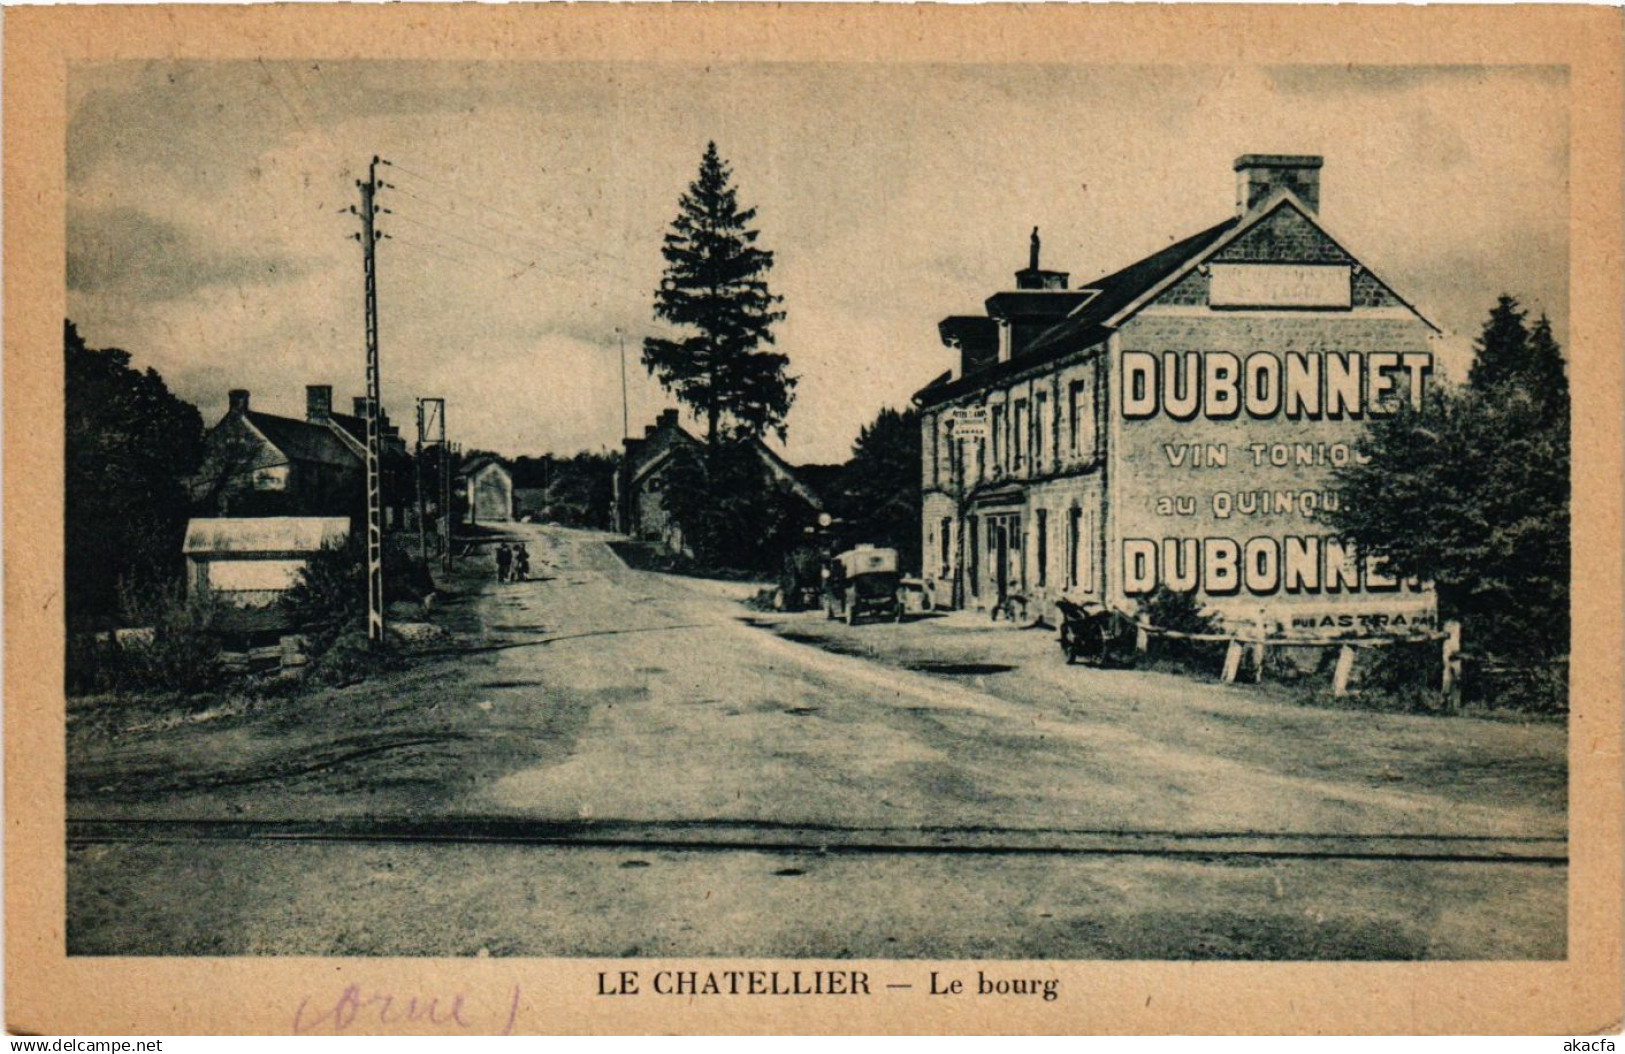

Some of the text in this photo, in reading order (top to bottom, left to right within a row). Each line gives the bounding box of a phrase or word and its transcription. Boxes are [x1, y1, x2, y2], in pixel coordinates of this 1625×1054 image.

[1121, 350, 1433, 421] DUBONNET
[1164, 443, 1228, 467] VIN
[1156, 490, 1350, 518] au QUINQU
[1123, 536, 1422, 596] DUBONNE
[1319, 613, 1406, 627] ASTRA
